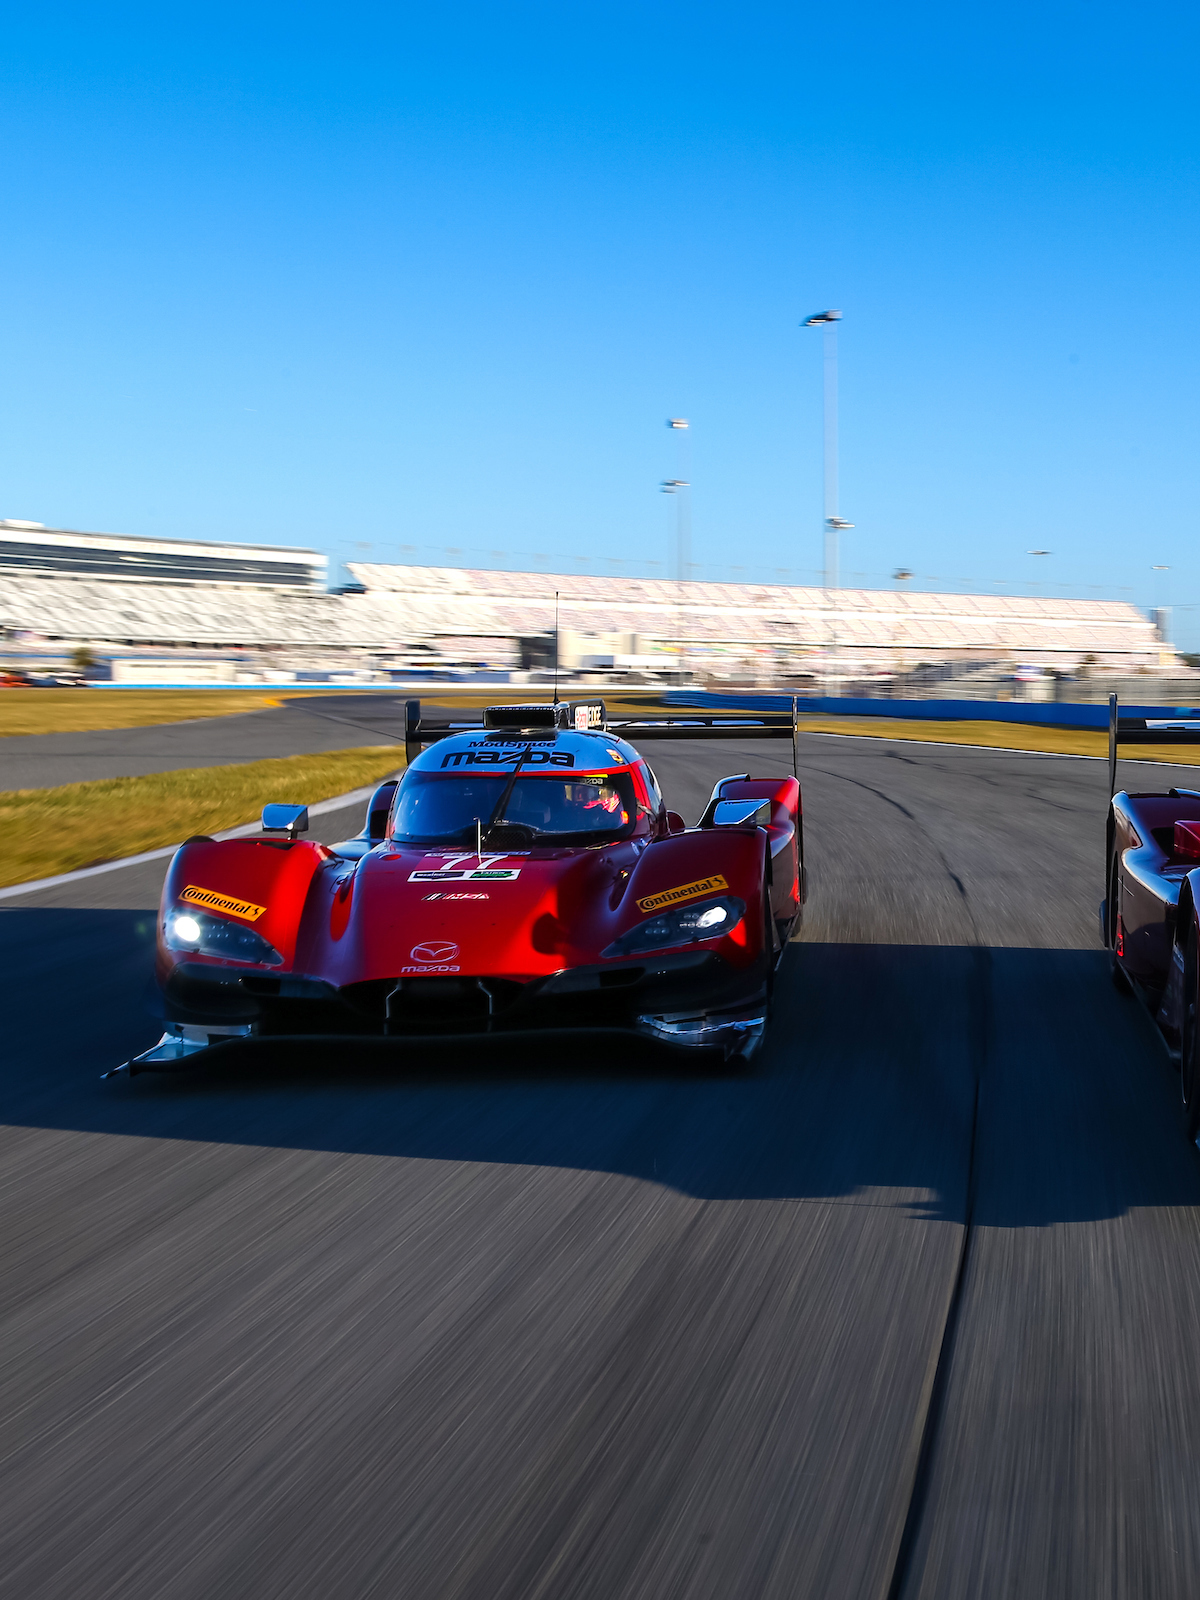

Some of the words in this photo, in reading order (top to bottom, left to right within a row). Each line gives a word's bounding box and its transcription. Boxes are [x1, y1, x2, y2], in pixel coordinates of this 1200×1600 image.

[440, 855, 508, 870] 77
[181, 887, 251, 914] Continental
[639, 879, 713, 910] Continental
